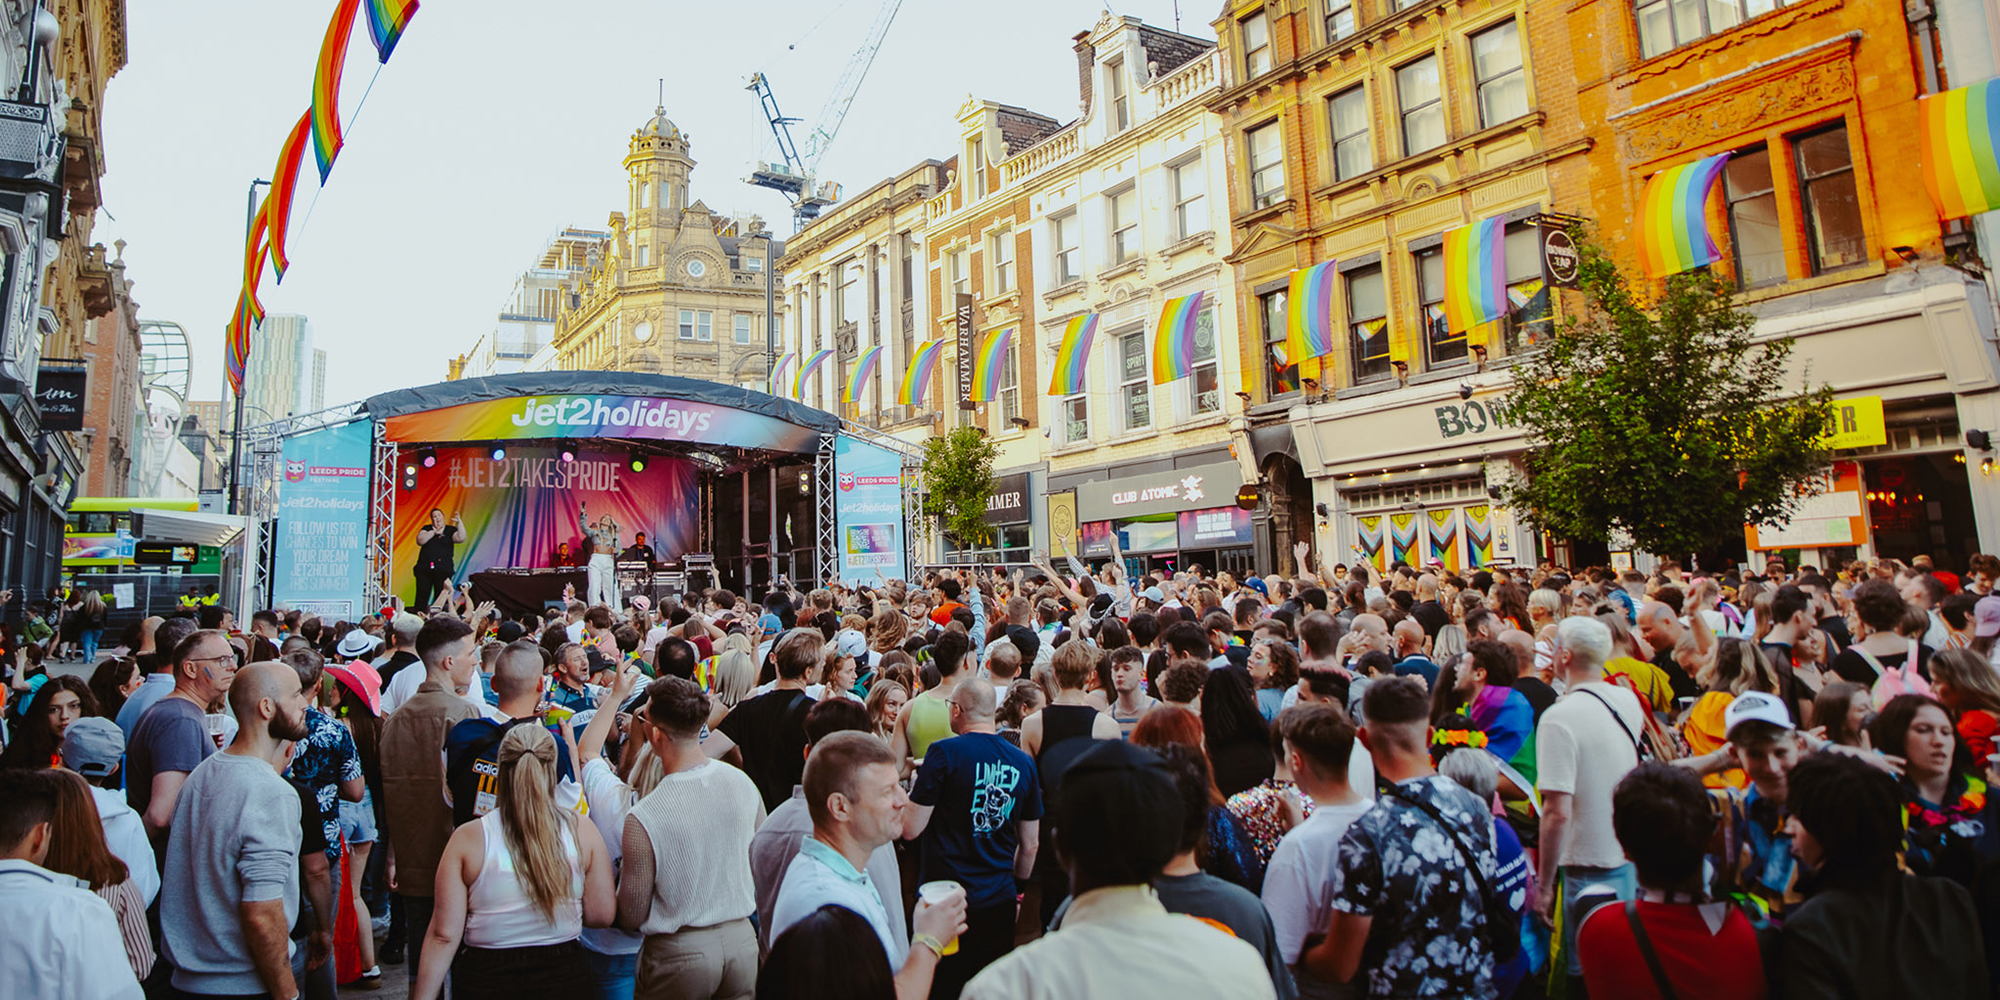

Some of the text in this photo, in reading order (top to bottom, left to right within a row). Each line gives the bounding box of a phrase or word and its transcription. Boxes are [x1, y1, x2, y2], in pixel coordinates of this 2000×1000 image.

[959, 304, 971, 402] WARHAMMER
[1126, 354, 1145, 370] SPIRIT
[449, 457, 620, 491] #JET2TAKESPRIDE
[1112, 485, 1178, 504] CLUB ATOMIC
[289, 521, 356, 534] FOLLOW US FOR
[284, 535, 358, 549] CHANCES TO WIN
[293, 549, 349, 562] YOUR DREAM
[290, 563, 349, 577] JET2HOLIDAY
[290, 577, 308, 590] THIS
